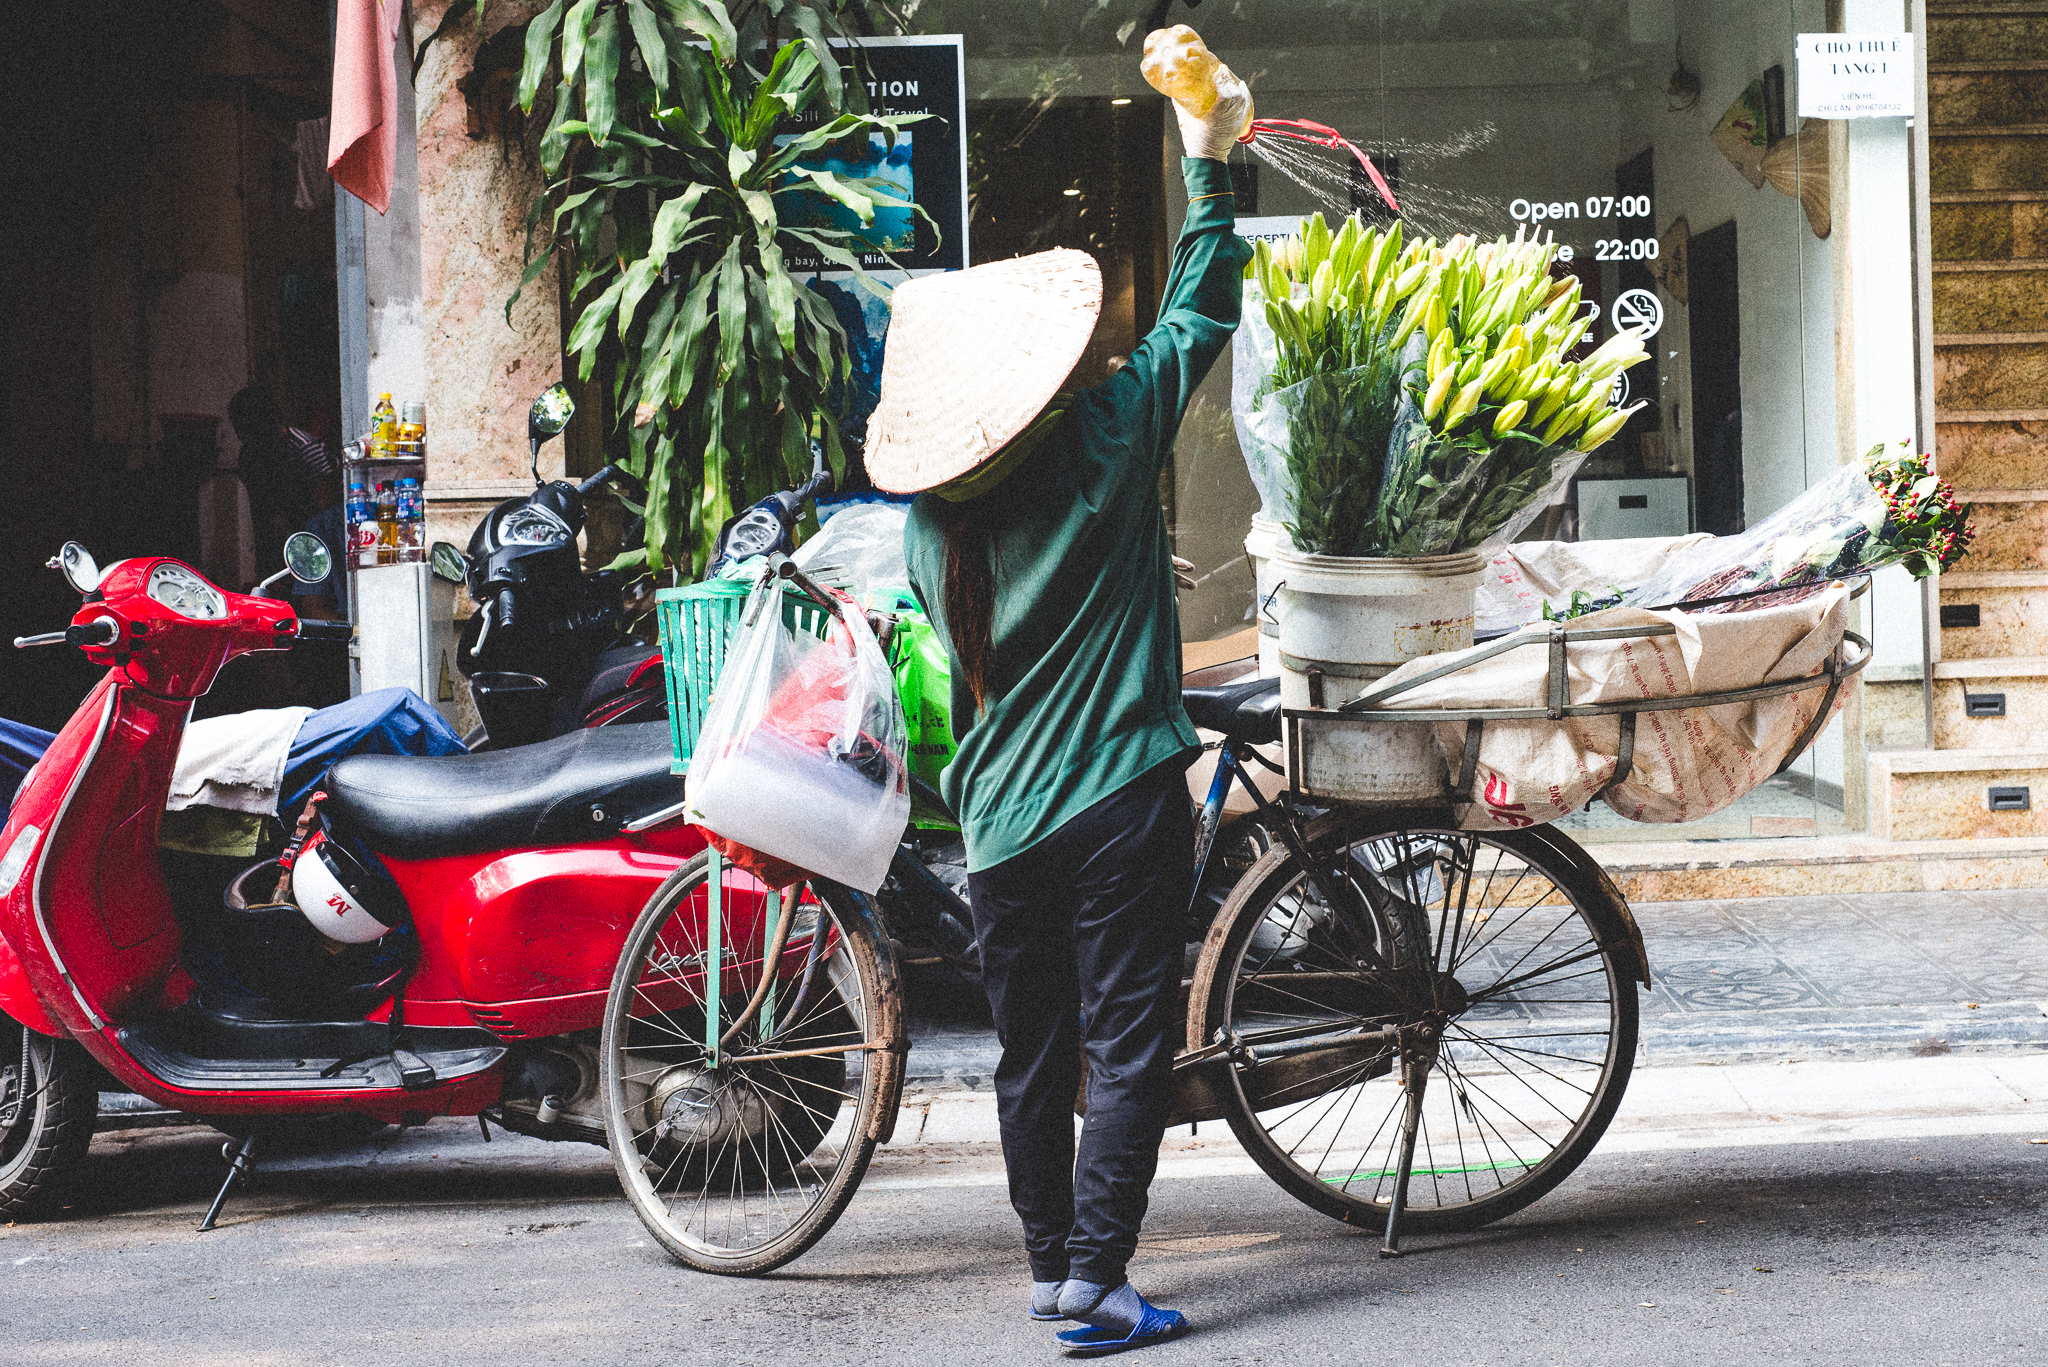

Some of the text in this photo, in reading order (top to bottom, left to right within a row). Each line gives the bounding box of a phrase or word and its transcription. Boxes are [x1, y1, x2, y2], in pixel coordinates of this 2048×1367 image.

[1815, 42, 1851, 54] CHO
[866, 80, 919, 97] TION
[1509, 195, 1651, 225] Open 07:00
[1594, 238, 1660, 261] 22:00
[795, 256, 819, 267] bay,
